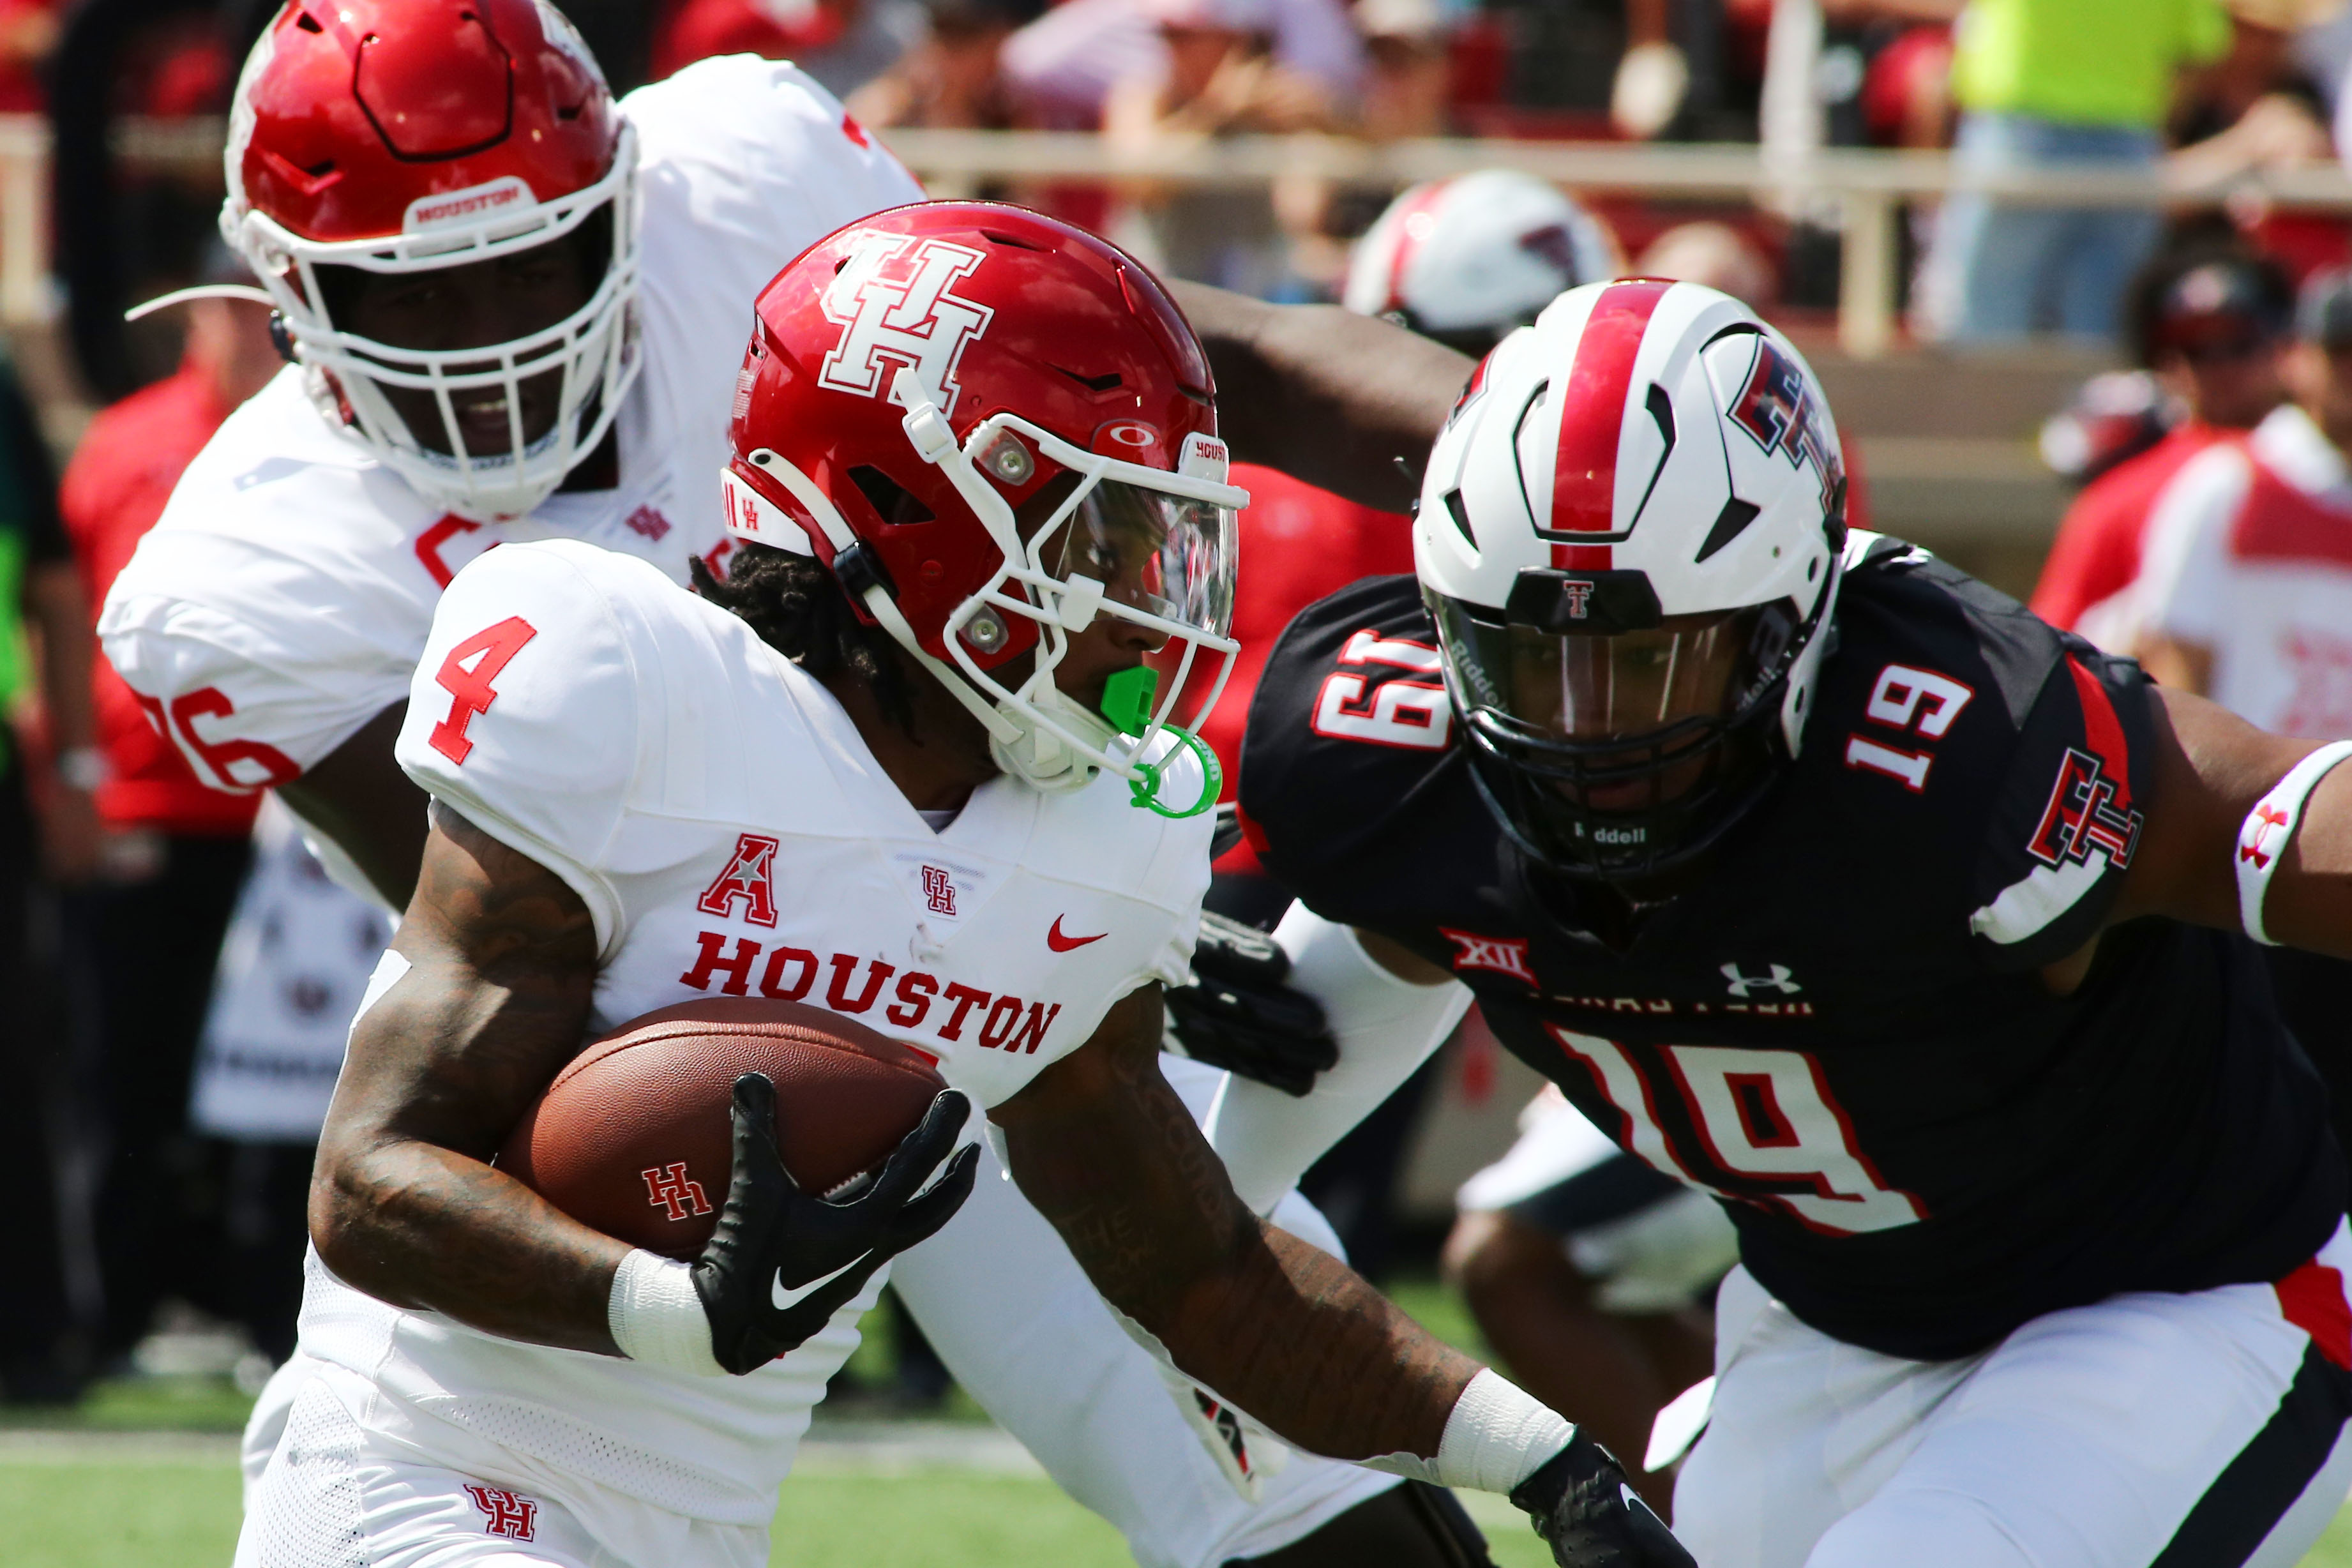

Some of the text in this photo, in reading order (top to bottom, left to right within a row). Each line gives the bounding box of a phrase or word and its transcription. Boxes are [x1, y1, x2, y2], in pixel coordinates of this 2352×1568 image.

[416, 186, 519, 223] HOUSTON
[428, 615, 538, 766] 4
[1310, 628, 1455, 752] 19
[1844, 661, 1975, 794] 19
[696, 833, 779, 929] A
[922, 864, 956, 916] UH
[679, 931, 1062, 1055] HOUSTON
[1447, 932, 1533, 981] XII
[1543, 1021, 1932, 1238] 19
[463, 1483, 538, 1542] UH
